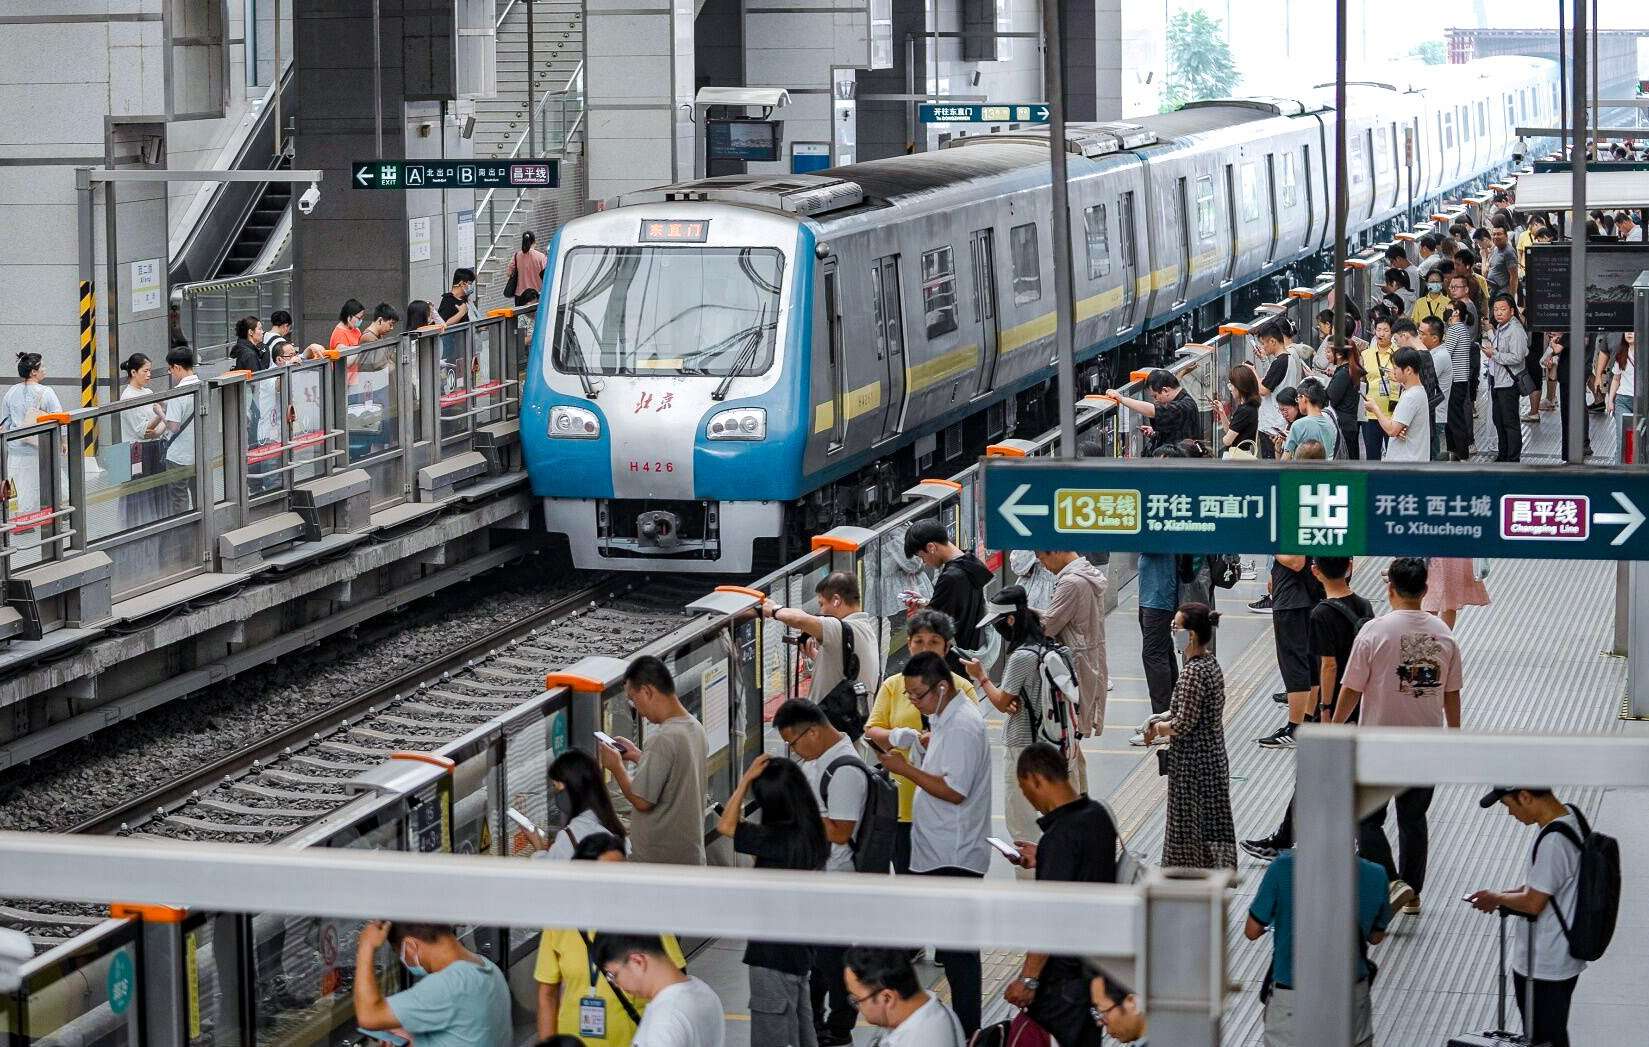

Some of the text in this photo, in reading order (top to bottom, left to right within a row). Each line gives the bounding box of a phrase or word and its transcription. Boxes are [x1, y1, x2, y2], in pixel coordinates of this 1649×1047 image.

[410, 168, 422, 183] A
[461, 168, 473, 182] B
[513, 167, 547, 178] 昌平线
[648, 223, 703, 238] 东直门
[634, 391, 675, 414] 北京
[629, 462, 673, 473] H426
[1059, 495, 1097, 528] 13
[1096, 495, 1136, 516] 号线
[1147, 494, 1264, 519] 开往 西直门
[1374, 494, 1493, 518] 开往 西土城
[1511, 500, 1580, 525] 昌平线
[1147, 519, 1216, 532] To Xizhimen
[1385, 521, 1483, 538] To Xitucheng
[1559, 524, 1580, 535] Line
[1298, 528, 1347, 546] EXIT
